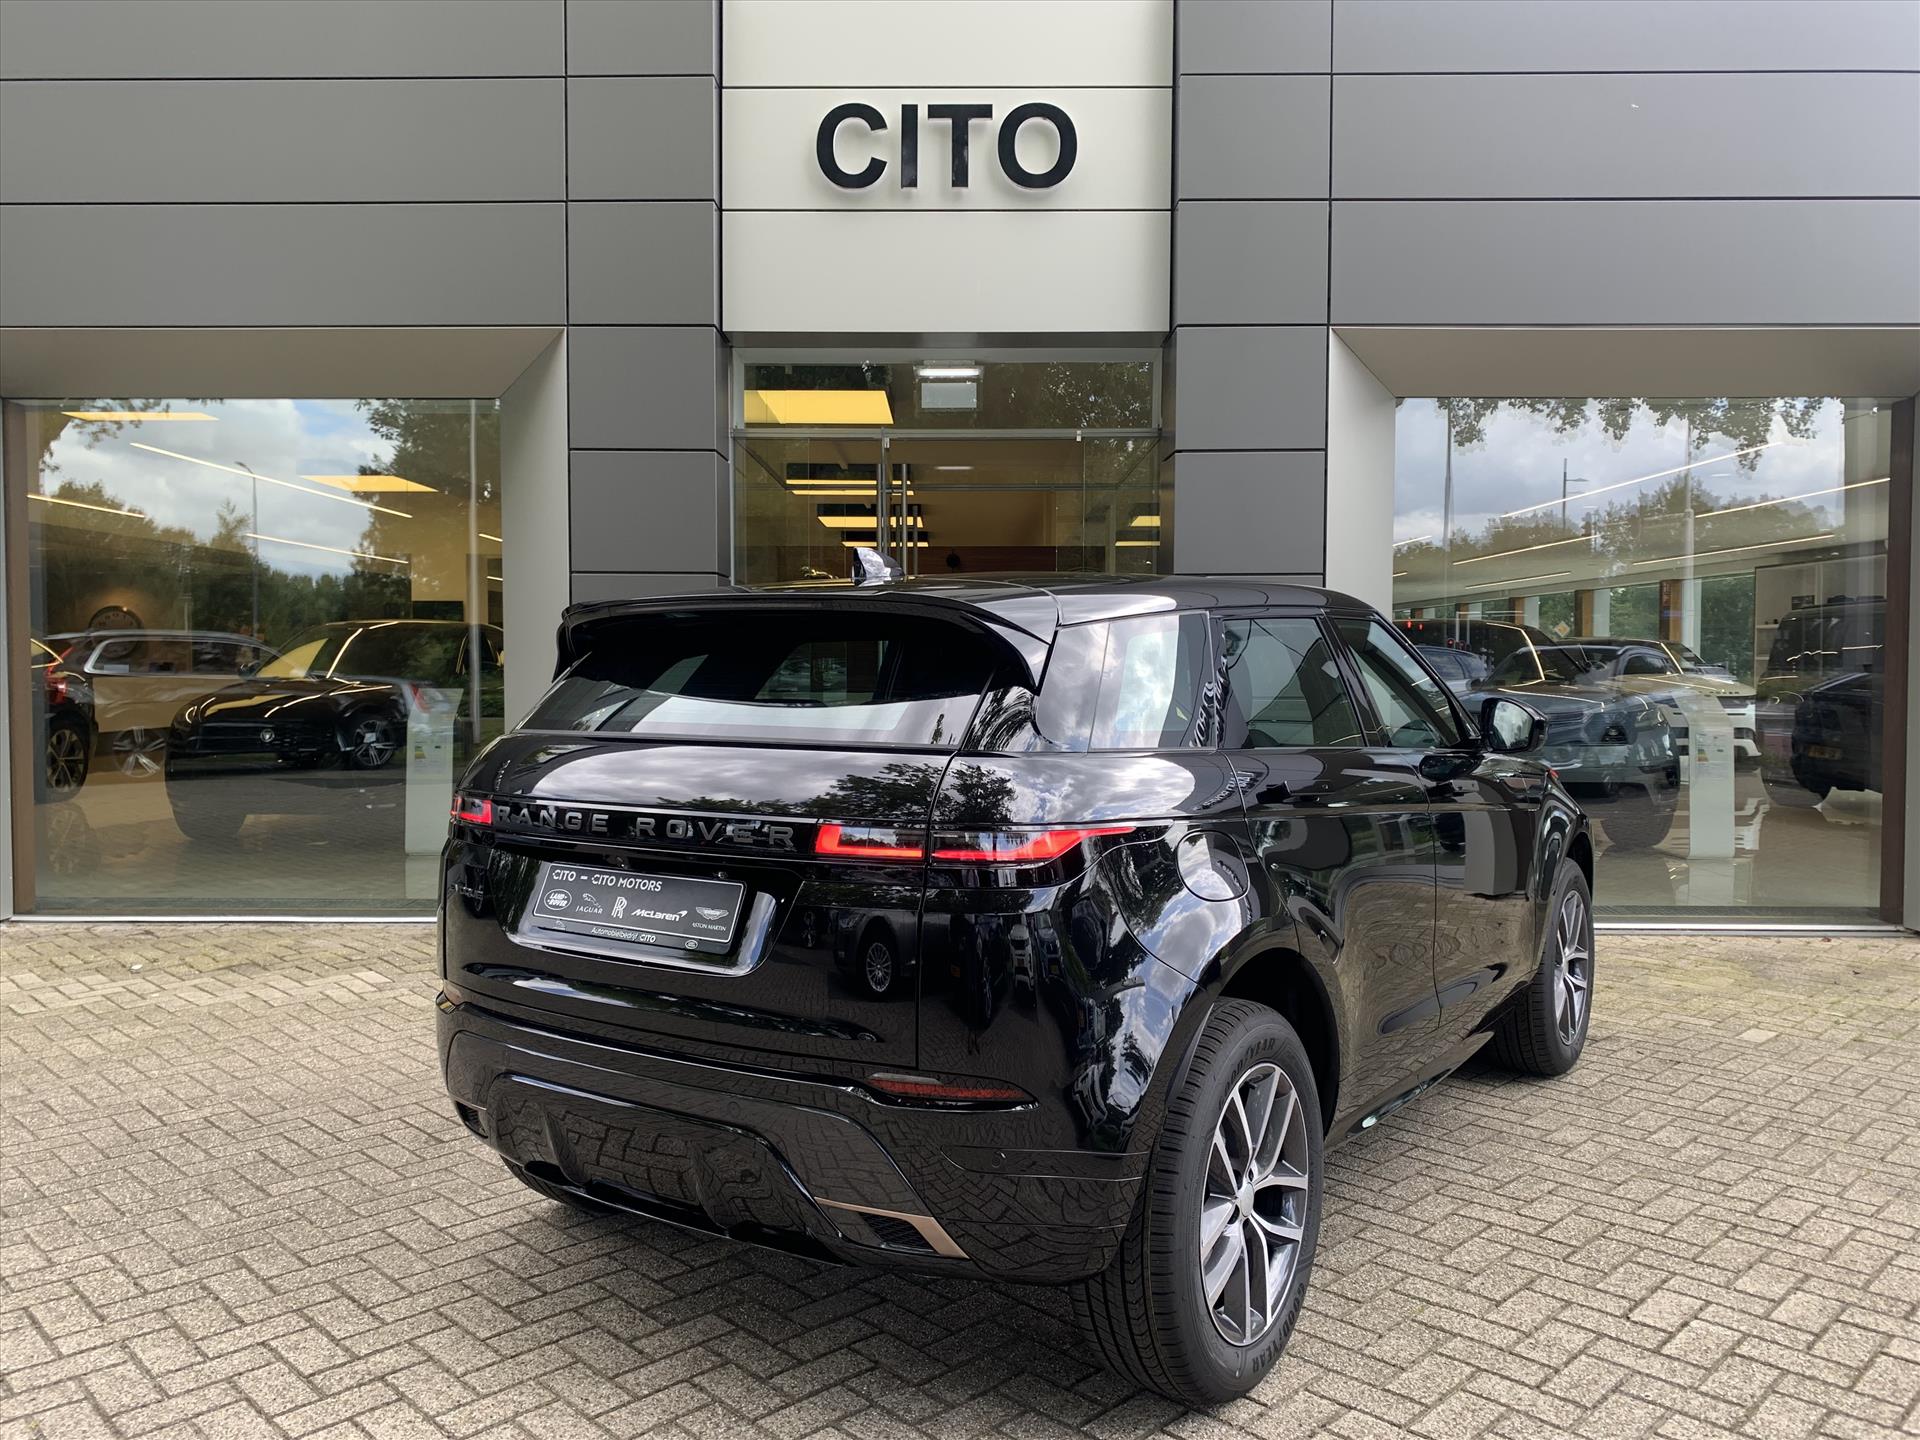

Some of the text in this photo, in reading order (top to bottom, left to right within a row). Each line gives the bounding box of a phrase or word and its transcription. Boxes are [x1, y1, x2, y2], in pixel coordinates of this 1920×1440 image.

[816, 102, 1078, 190] CITO
[498, 805, 796, 848] RANGE ROVER
[552, 869, 577, 881] CITO
[591, 874, 616, 887] CITO
[617, 877, 663, 892] MOTORS
[575, 905, 604, 914] JAGUAR
[631, 908, 681, 922] McLaren
[707, 924, 727, 932] MARTIN
[639, 934, 657, 943] CITO
